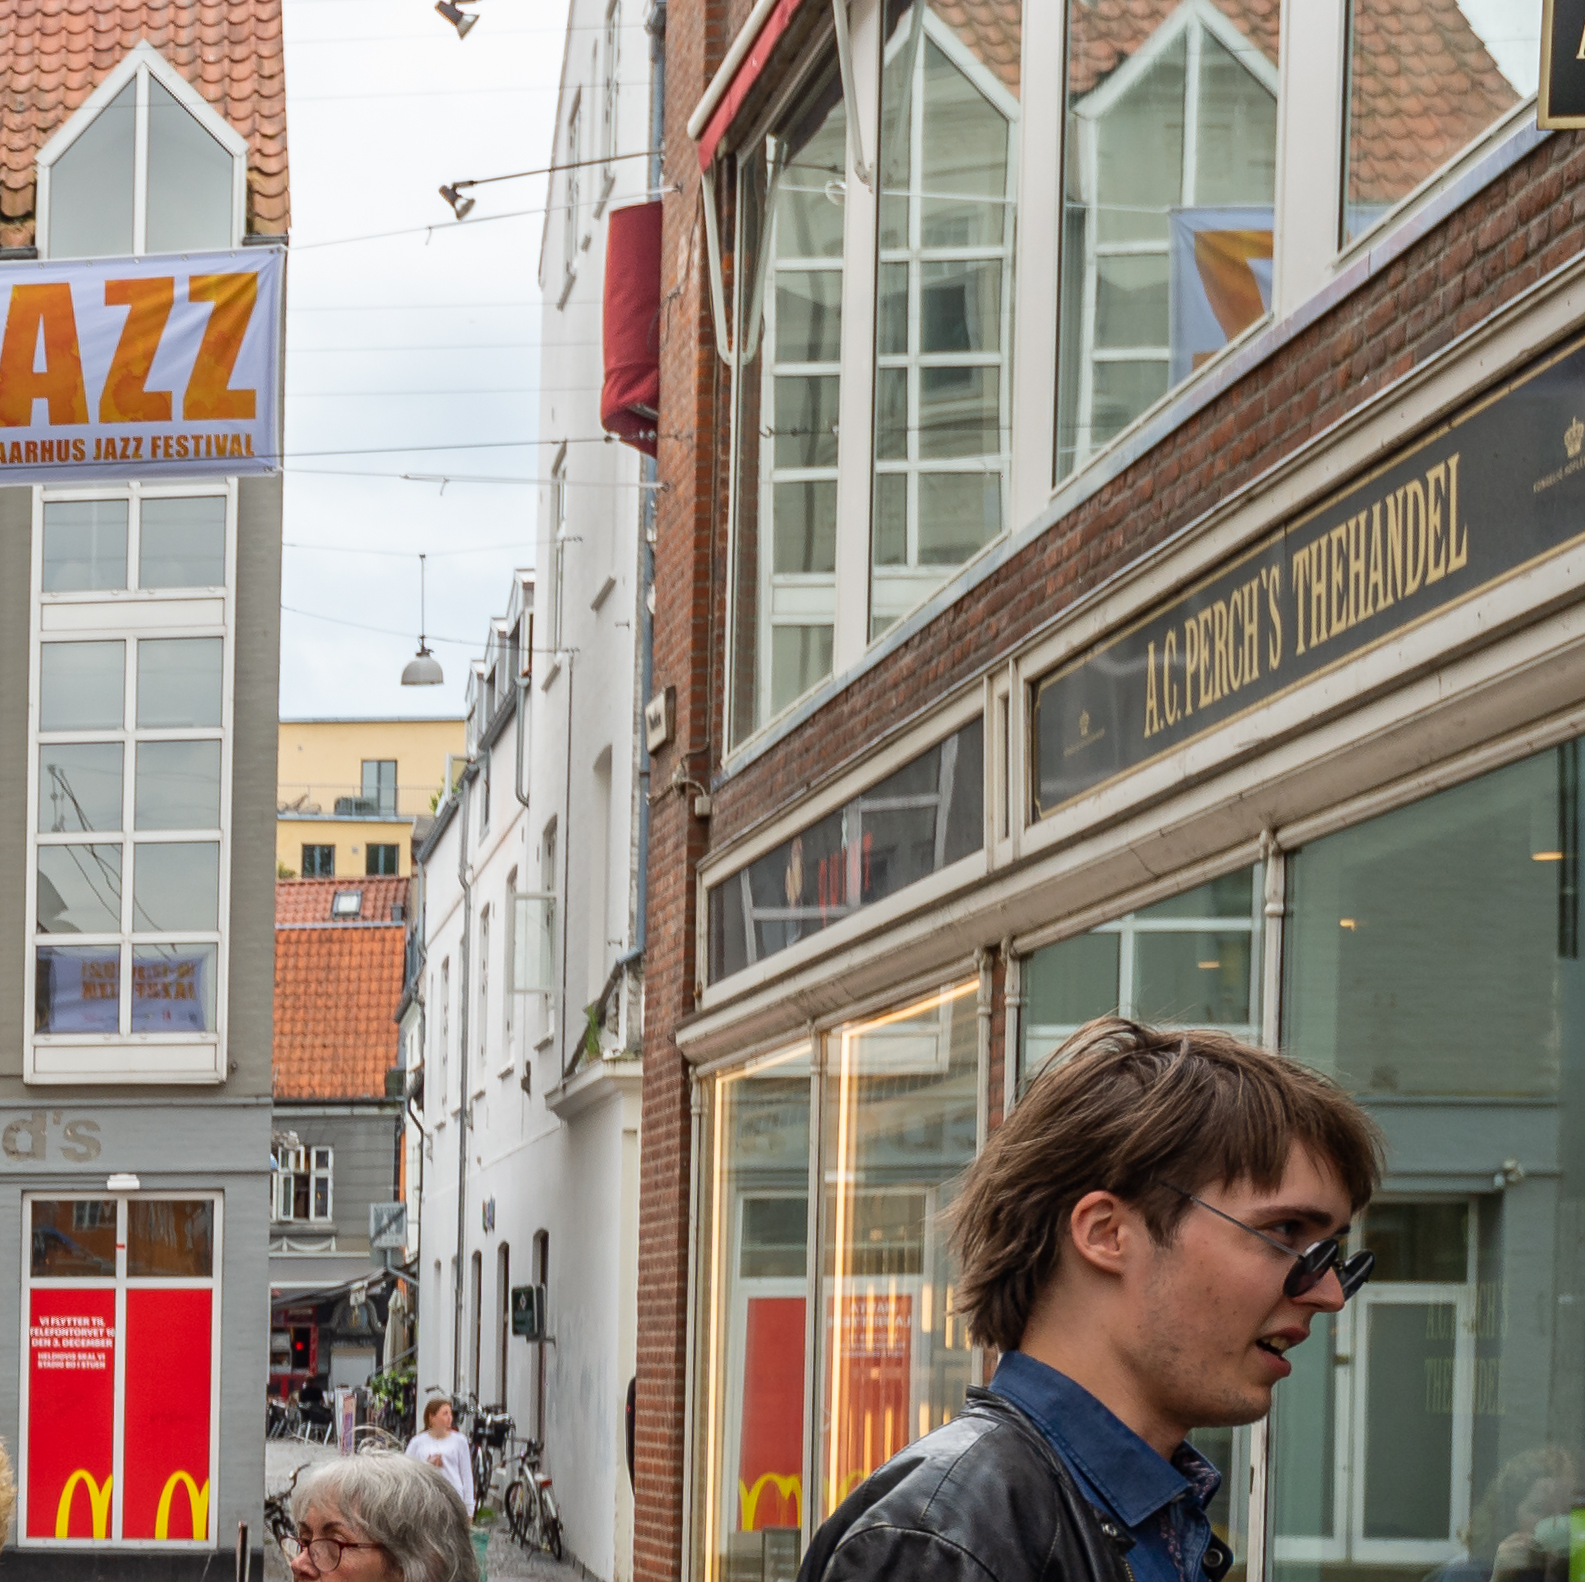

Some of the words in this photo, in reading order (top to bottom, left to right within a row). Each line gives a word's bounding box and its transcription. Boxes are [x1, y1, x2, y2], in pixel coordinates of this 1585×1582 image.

[93, 436, 143, 461] JAZZ
[150, 433, 256, 459] FESTIVAL
[1144, 630, 1181, 739] A.C.
[1292, 452, 1469, 657] THEHANDEL
[62, 1337, 113, 1348] DECEMBER
